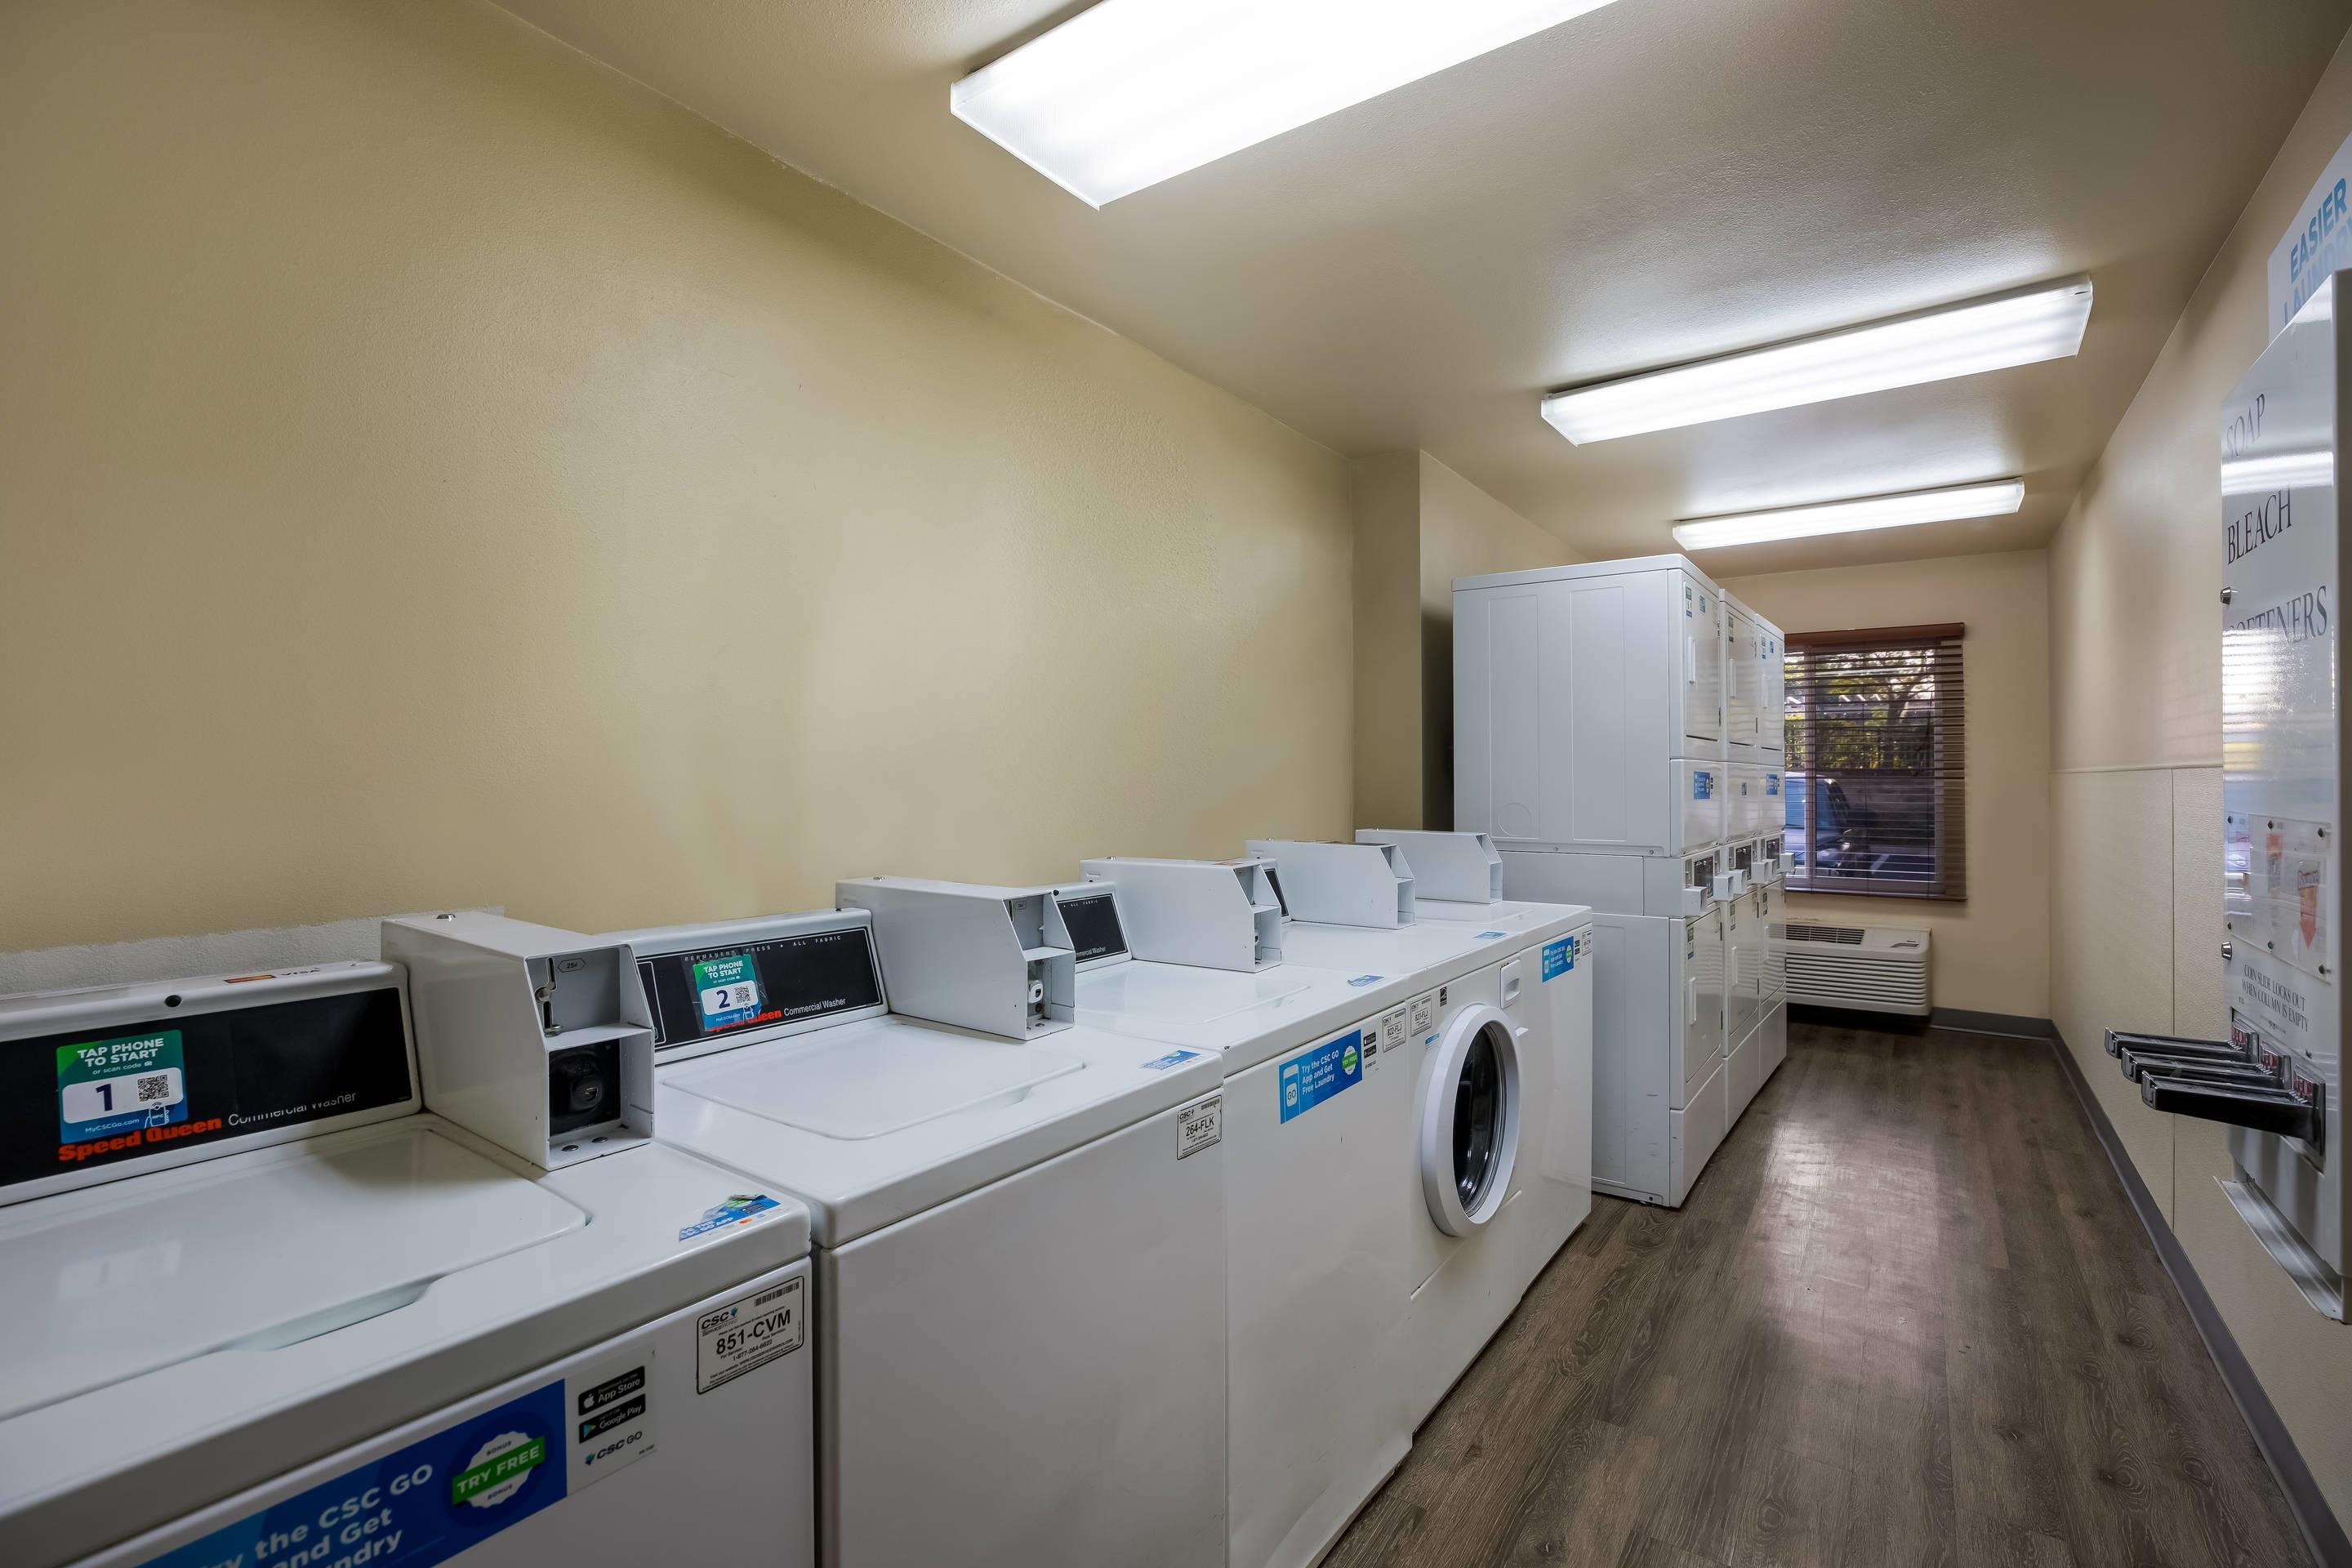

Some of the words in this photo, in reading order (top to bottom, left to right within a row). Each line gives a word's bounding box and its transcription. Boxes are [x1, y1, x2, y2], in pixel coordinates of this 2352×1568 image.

[2290, 177, 2347, 285] EASIER
[2226, 393, 2265, 458] SOAP
[2227, 488, 2292, 565] BLEACH
[2230, 585, 2328, 644] TENERS
[746, 945, 771, 953] PRESS
[815, 935, 842, 944] FABRIC
[704, 965, 718, 973] TAP
[719, 960, 744, 970] PHONE
[719, 967, 742, 977] START
[716, 990, 731, 1009] 2
[783, 1002, 822, 1017] Commercial
[822, 997, 846, 1009] Washer
[2242, 978, 2257, 999] WHEN
[2257, 989, 2281, 1014] COLUMN
[2282, 1002, 2287, 1018] IS
[2288, 1008, 2309, 1032] EMPTY
[2272, 980, 2291, 1002] LOCKS
[2292, 992, 2306, 1012] OUT
[77, 1046, 108, 1058] TAP
[111, 1038, 164, 1054] PHONE
[85, 1057, 106, 1067] TO
[110, 1049, 158, 1063] START
[1302, 1065, 1311, 1074] Try
[1311, 1060, 1320, 1070] the
[1321, 1054, 1331, 1065] CSC
[1331, 1050, 1339, 1059] GO
[1302, 1076, 1312, 1085] App
[1313, 1069, 1323, 1078] and
[1324, 1063, 1333, 1074] Get
[1287, 1089, 1297, 1100] GO
[1302, 1085, 1313, 1095] Free
[1314, 1073, 1335, 1089] Laundry
[95, 1084, 113, 1111] 1
[85, 1117, 140, 1133] MyCSCGo.com
[1186, 1116, 1214, 1137] 264-FLK
[58, 1131, 141, 1161] Speed
[146, 1116, 222, 1142] Queen
[701, 1312, 729, 1330] CSC
[715, 1309, 791, 1355] 851-CVM
[598, 1390, 617, 1403] App
[617, 1379, 641, 1393] Store
[599, 1412, 626, 1429] Google
[626, 1405, 642, 1417] Play
[597, 1439, 626, 1459] CSC
[626, 1431, 643, 1445] GO
[457, 1468, 492, 1494] TRY
[496, 1446, 540, 1476] FREE
[255, 1525, 310, 1560] the
[318, 1487, 382, 1529] CSC
[390, 1464, 434, 1497] GO
[340, 1508, 393, 1544] Get
[325, 1530, 403, 1568] ndry
